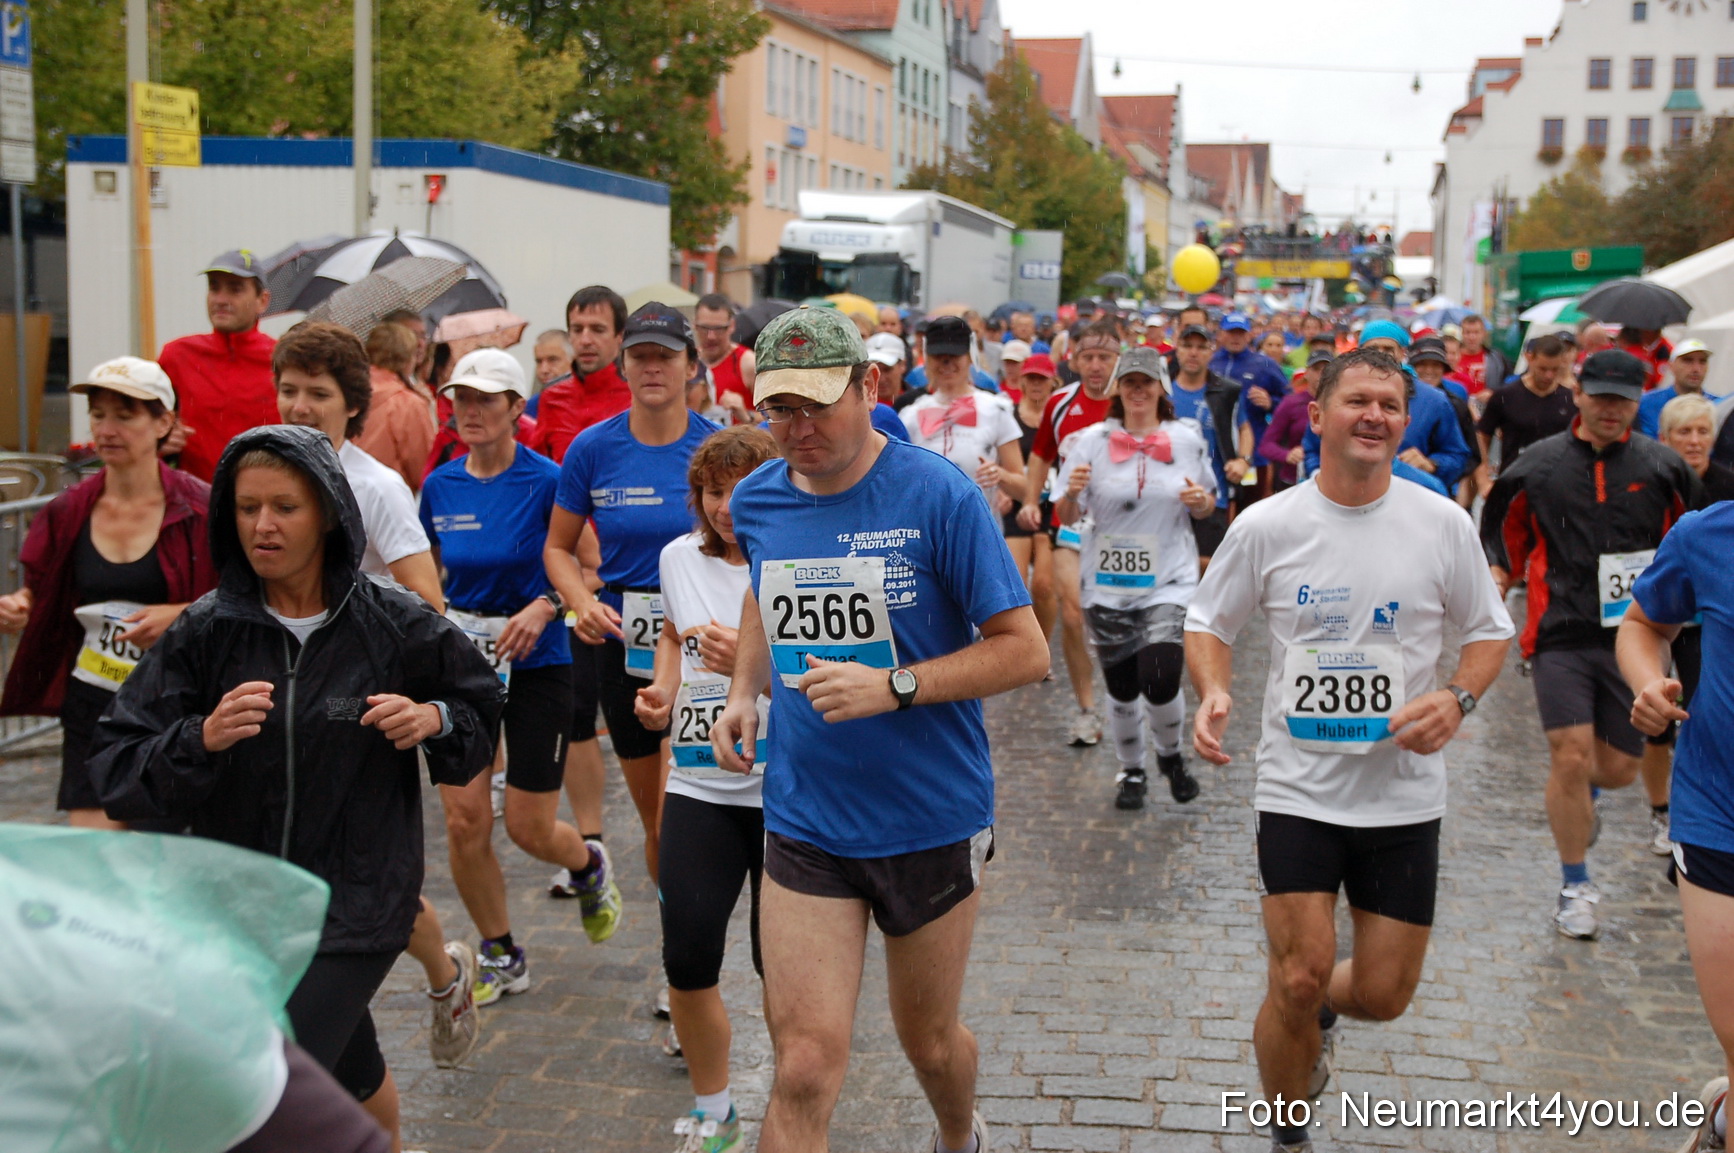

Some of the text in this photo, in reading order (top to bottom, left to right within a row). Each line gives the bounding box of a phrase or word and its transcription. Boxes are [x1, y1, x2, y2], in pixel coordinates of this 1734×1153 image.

[837, 528, 921, 543] 12. NEUMARKTER
[850, 539, 906, 551] STADTLAUF
[1100, 550, 1151, 572] 2385
[794, 566, 840, 580] BOCK
[1297, 585, 1315, 605] 6.
[772, 592, 876, 641] 2566
[1295, 674, 1392, 714] 2388
[1316, 723, 1368, 738] Hubert
